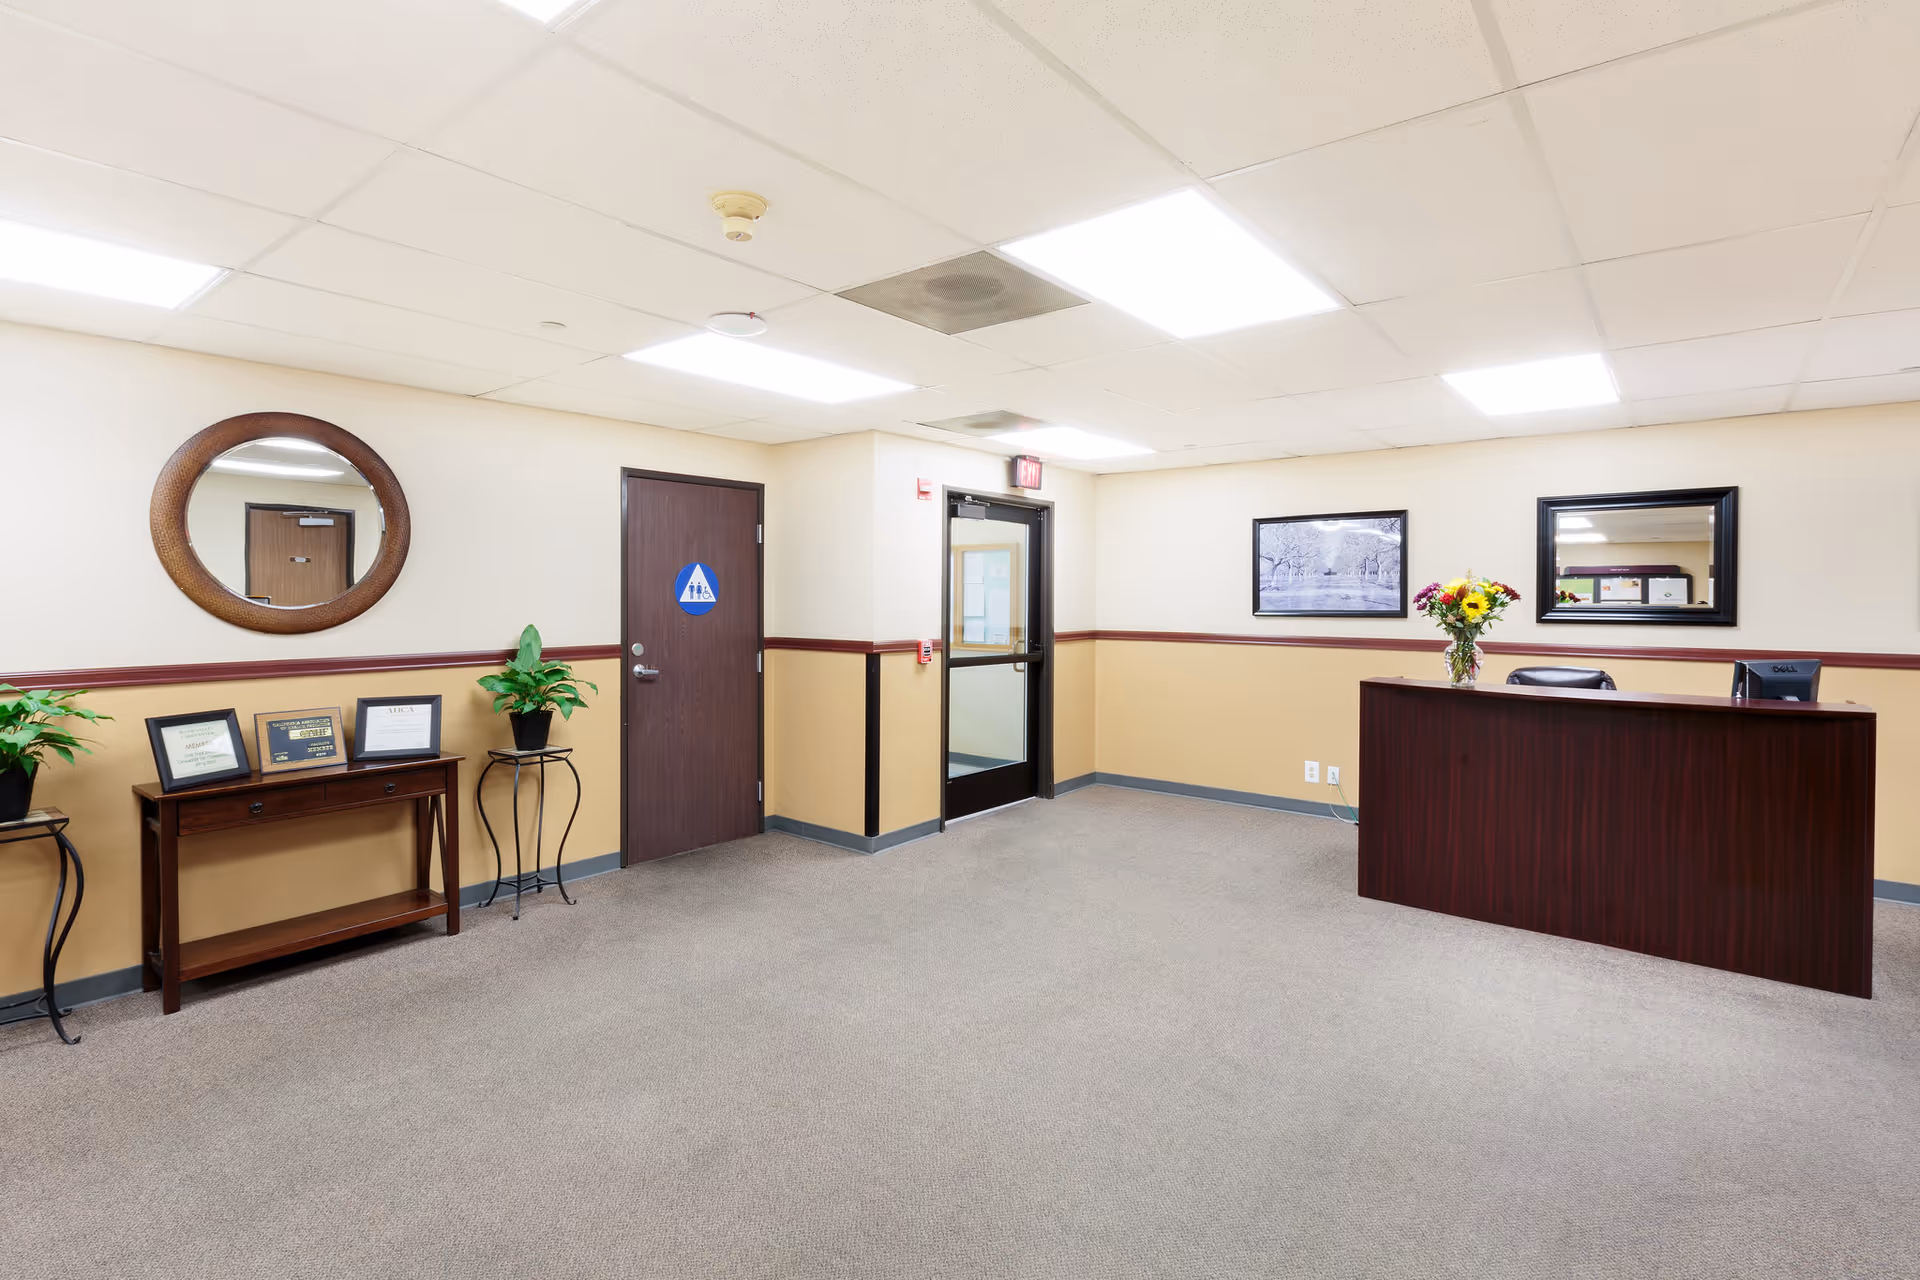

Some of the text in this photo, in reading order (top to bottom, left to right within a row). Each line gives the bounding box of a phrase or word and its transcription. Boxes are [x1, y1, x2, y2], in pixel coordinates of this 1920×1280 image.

[1020, 460, 1040, 488] EXIT
[1772, 664, 1798, 673] DELL
[385, 706, 417, 715] AHCA
[299, 728, 329, 737] CAHF
